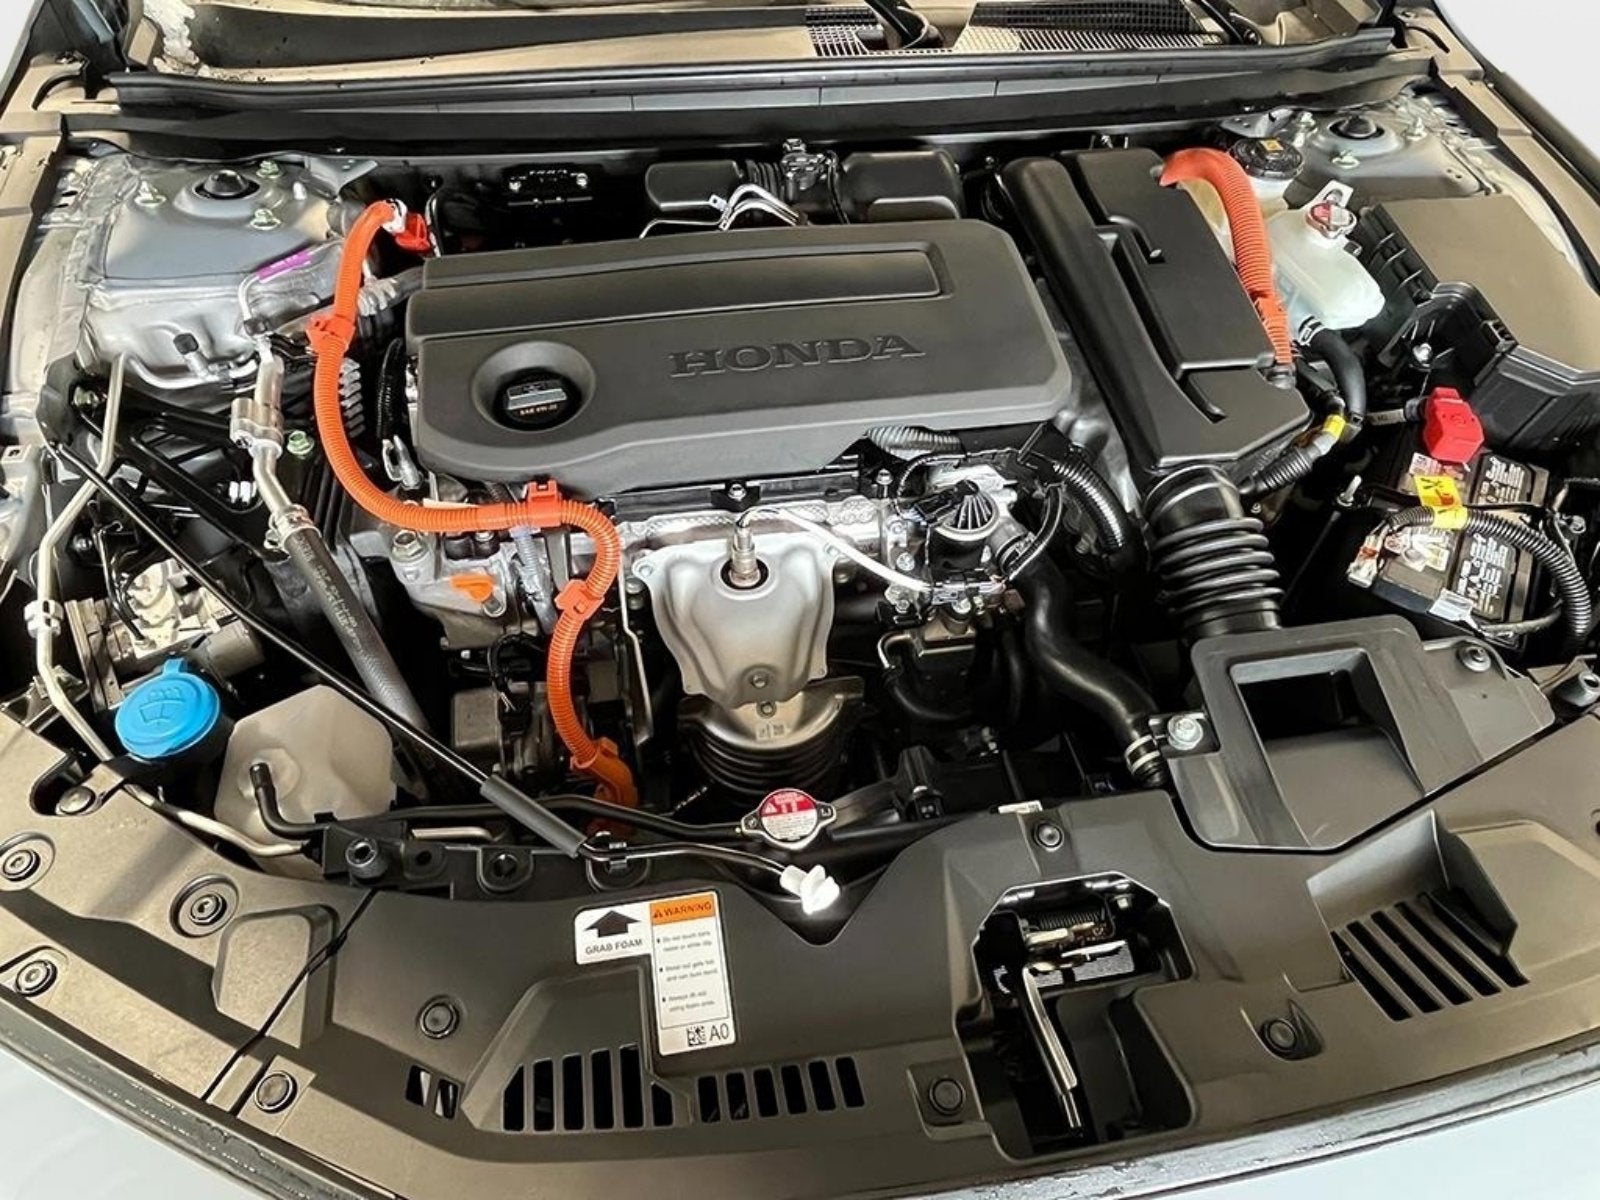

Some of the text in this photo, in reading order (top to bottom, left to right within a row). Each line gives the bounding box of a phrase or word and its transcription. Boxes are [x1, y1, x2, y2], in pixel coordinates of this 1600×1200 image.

[668, 334, 926, 377] HONDA
[664, 901, 712, 916] WARNING
[585, 938, 643, 955] GRAB FOAM
